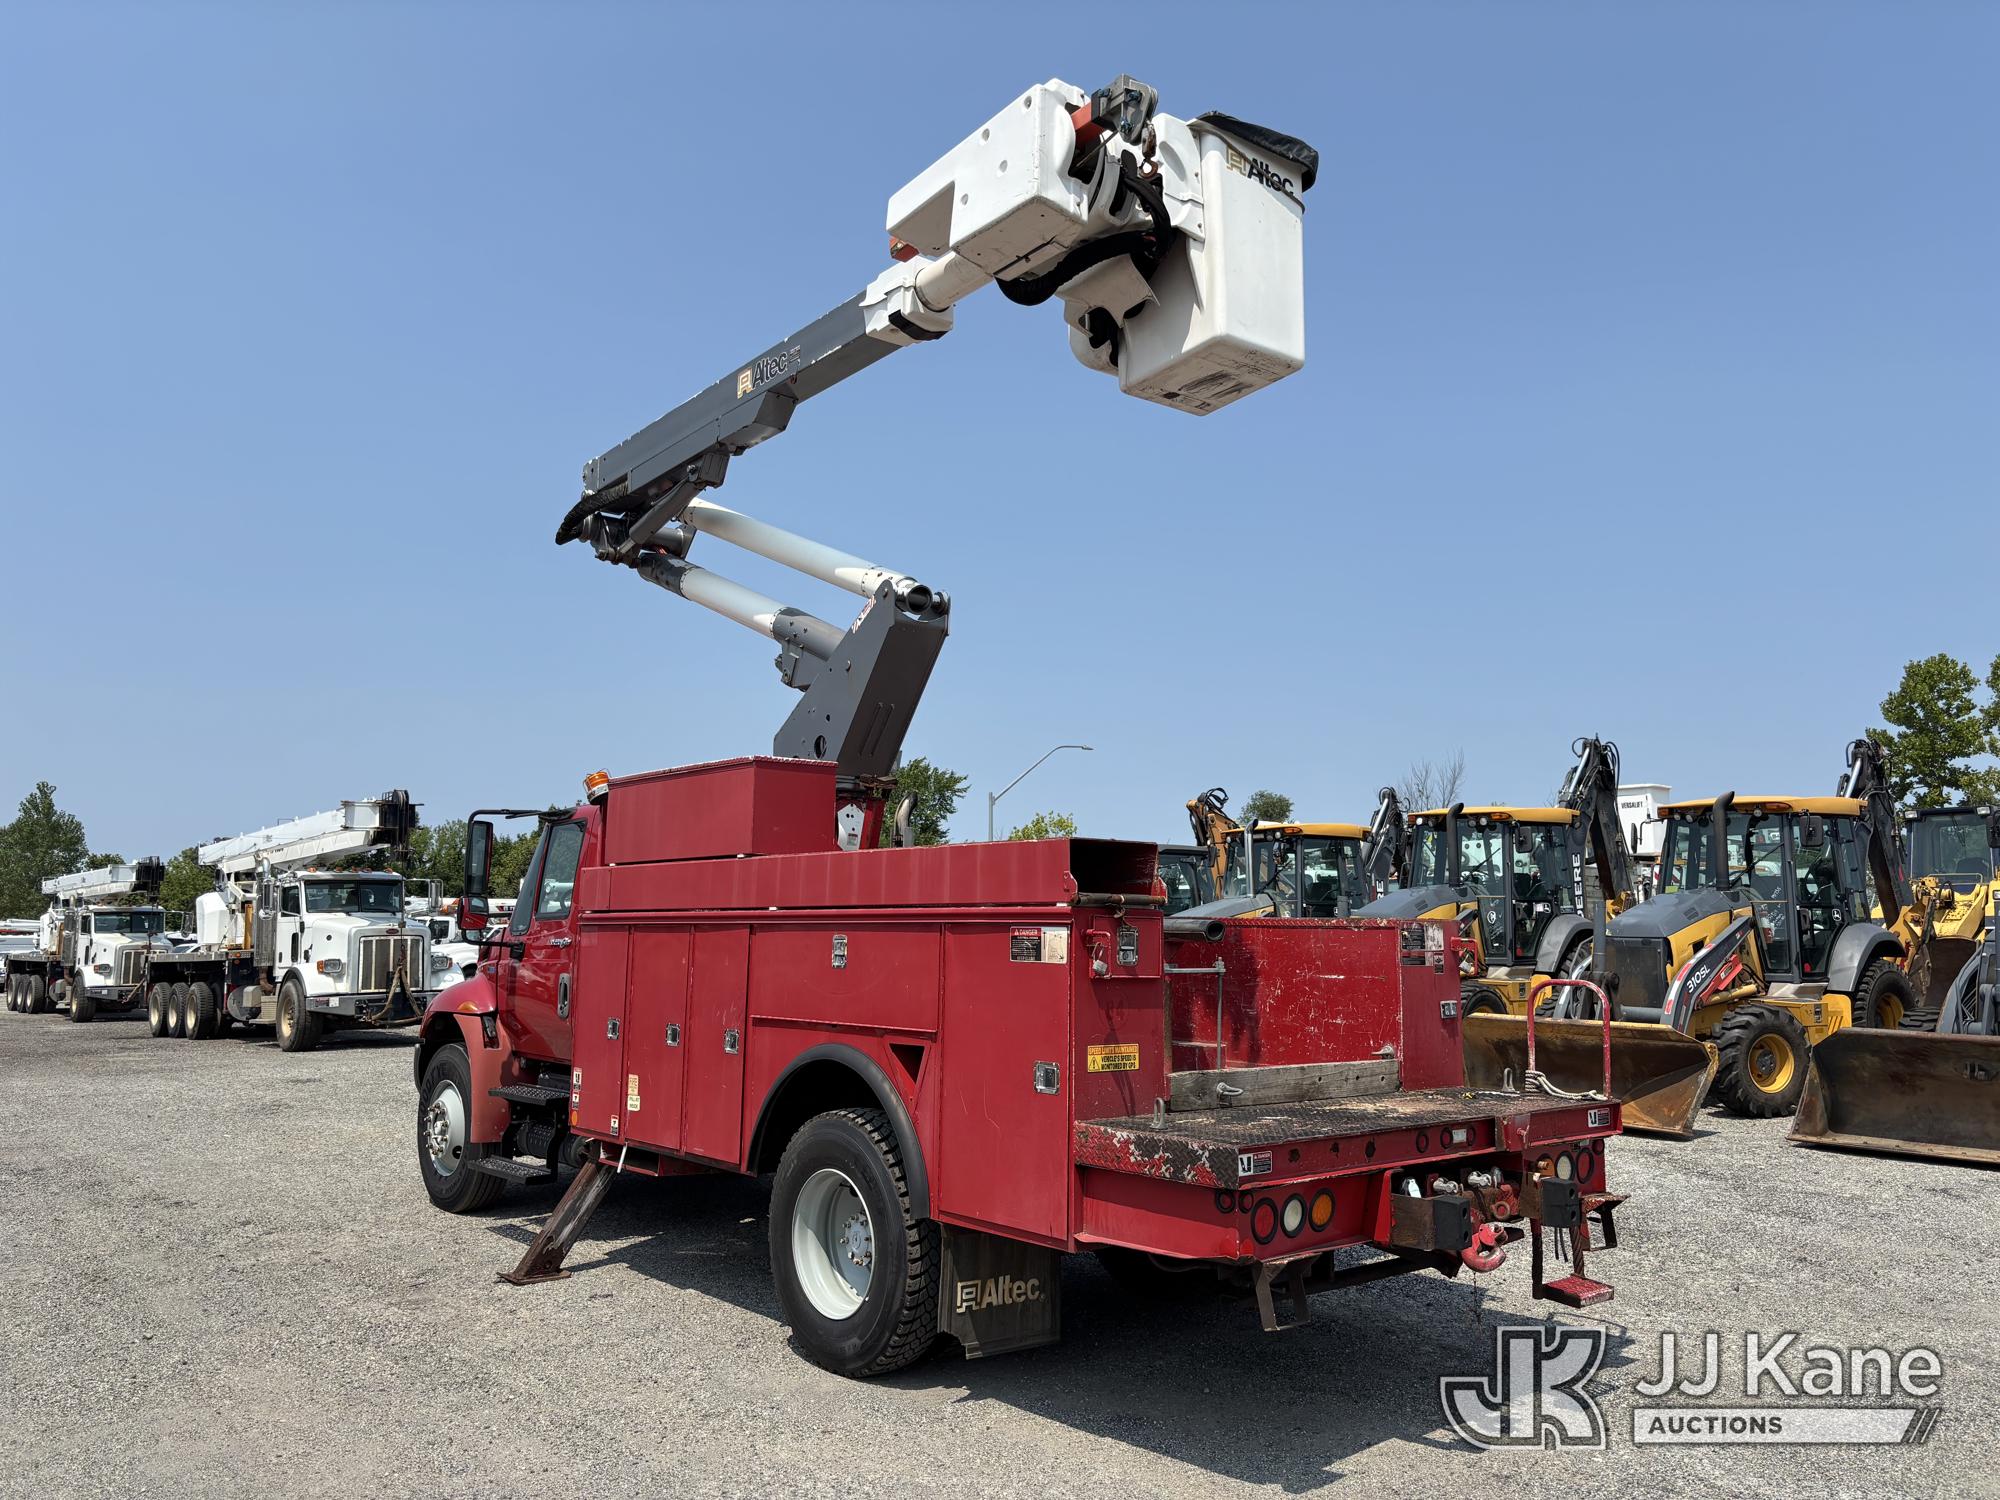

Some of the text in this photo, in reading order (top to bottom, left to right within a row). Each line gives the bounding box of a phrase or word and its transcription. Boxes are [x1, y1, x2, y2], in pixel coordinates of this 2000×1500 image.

[1247, 157, 1295, 198] Altec
[752, 351, 788, 390] Altec
[1621, 801, 1643, 809] VERSALIFT
[1686, 964, 1711, 993] 310SL
[1089, 1047, 1102, 1055] SPEED
[1120, 1054, 1132, 1062] SPEED
[1101, 1062, 1122, 1070] MONITORED
[1128, 1061, 1136, 1069] GPS
[981, 1275, 1040, 1309] Altec
